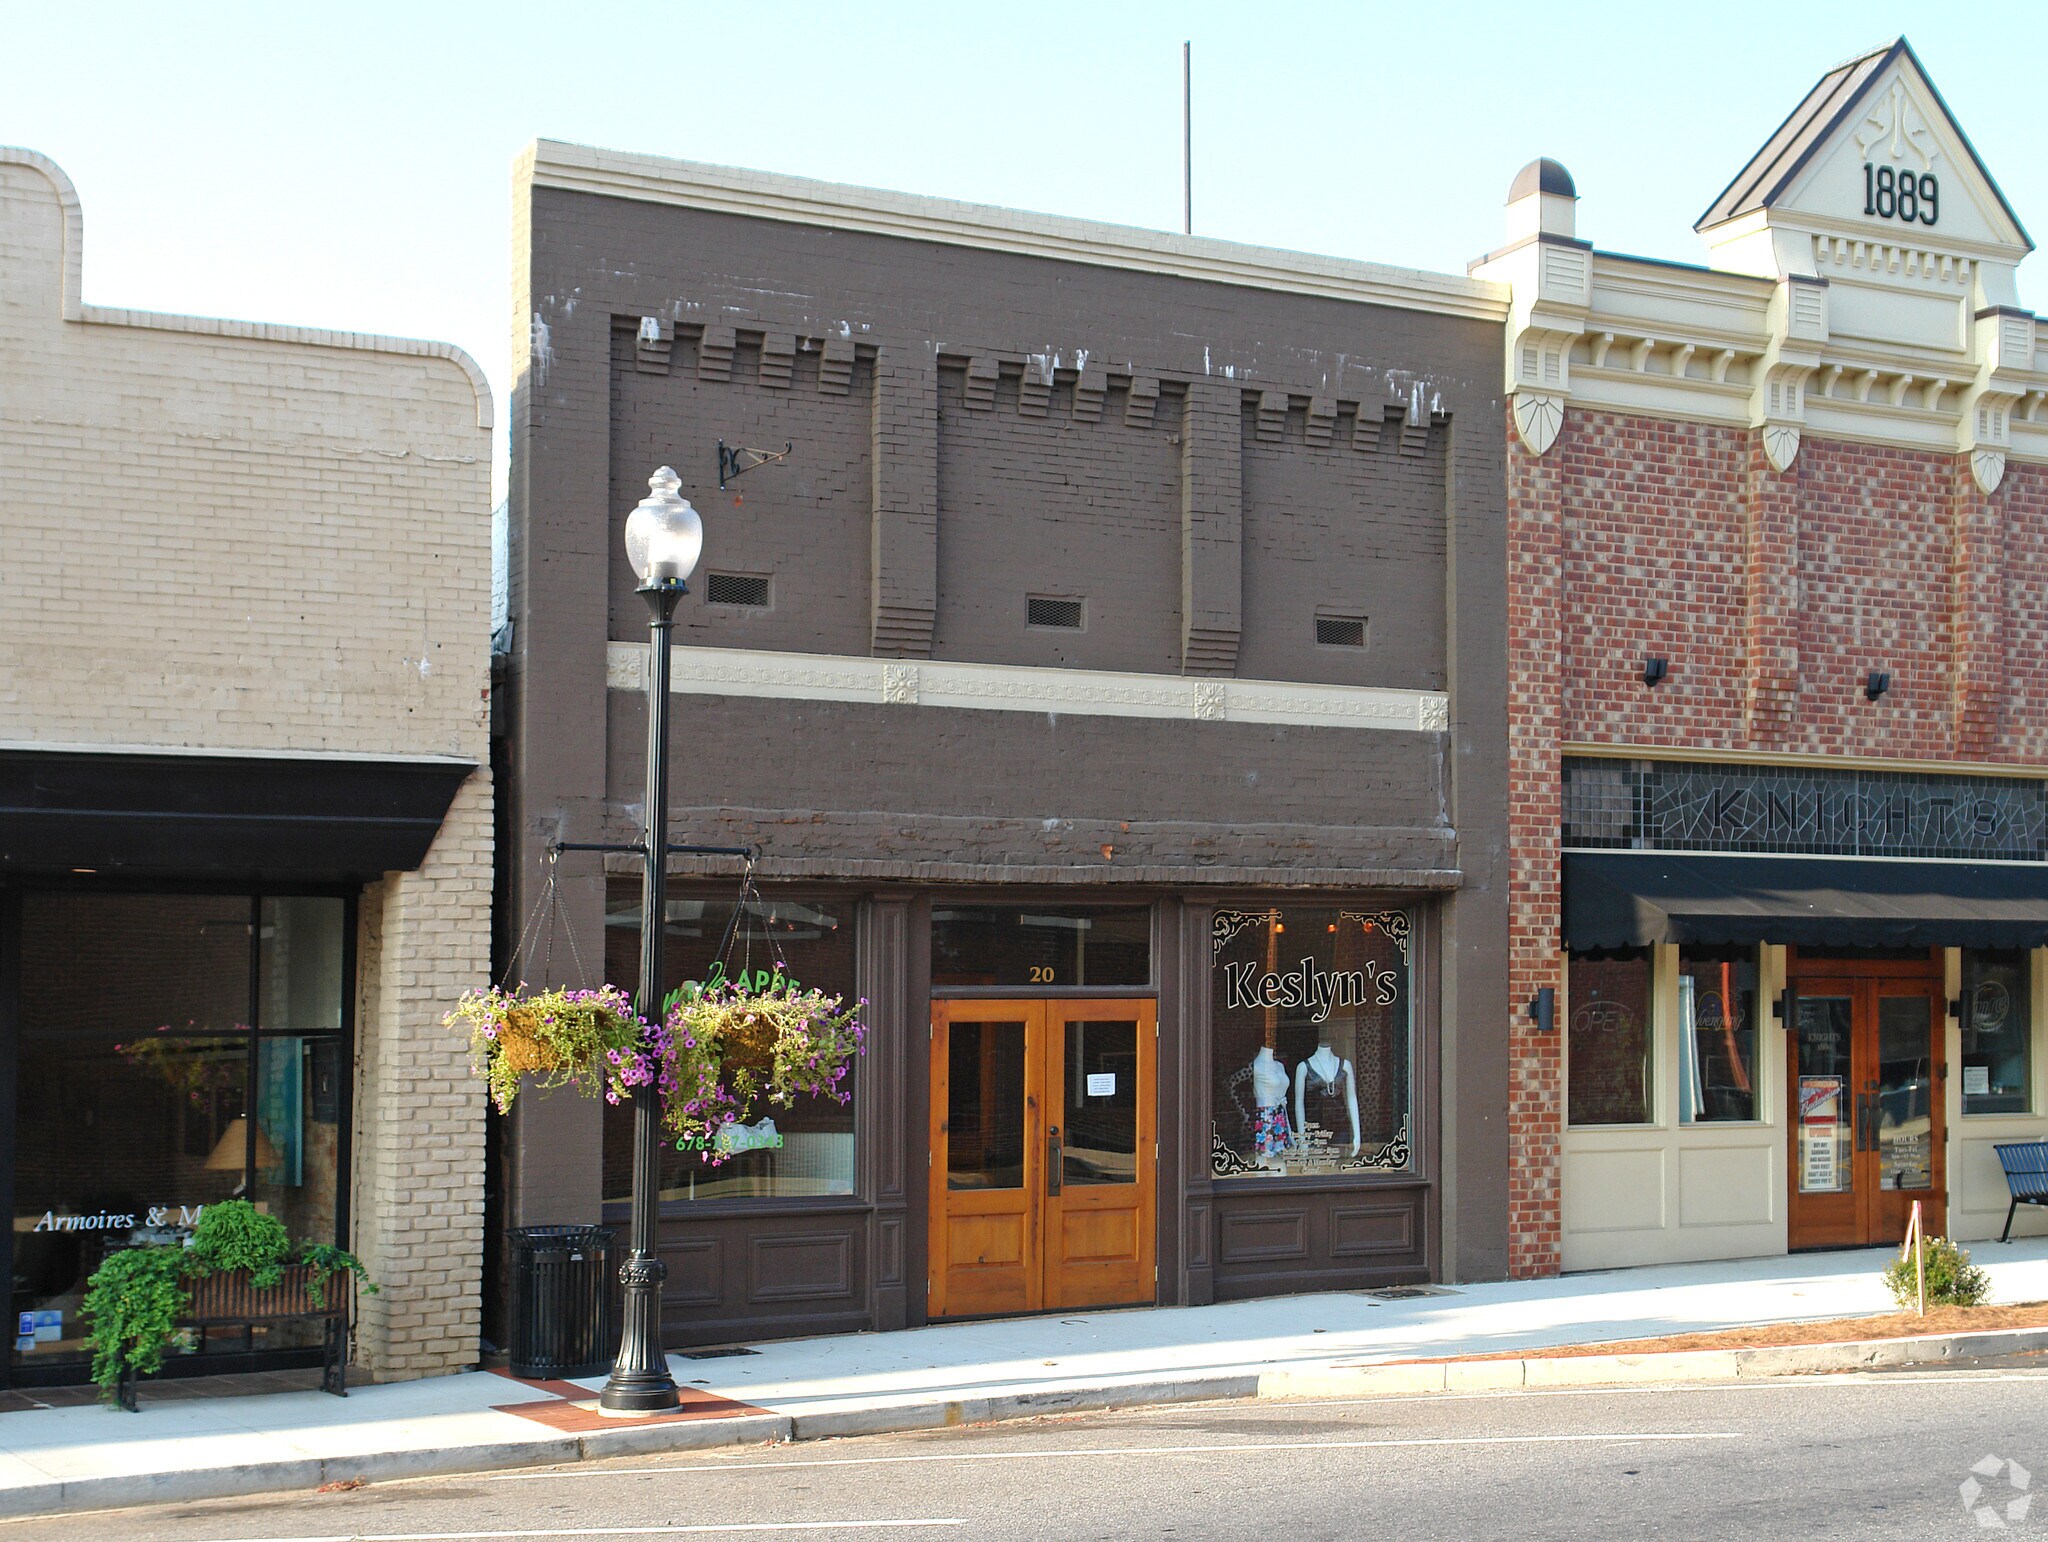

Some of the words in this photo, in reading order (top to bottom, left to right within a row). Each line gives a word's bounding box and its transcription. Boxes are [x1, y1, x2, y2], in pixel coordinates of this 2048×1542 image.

[1863, 162, 1939, 225] 1889
[1029, 966, 1055, 983] 20
[1224, 956, 1398, 1023] Keslyn's
[1893, 1135, 1919, 1144] HOURS
[33, 1209, 135, 1232] Armoires
[145, 1206, 168, 1227] &
